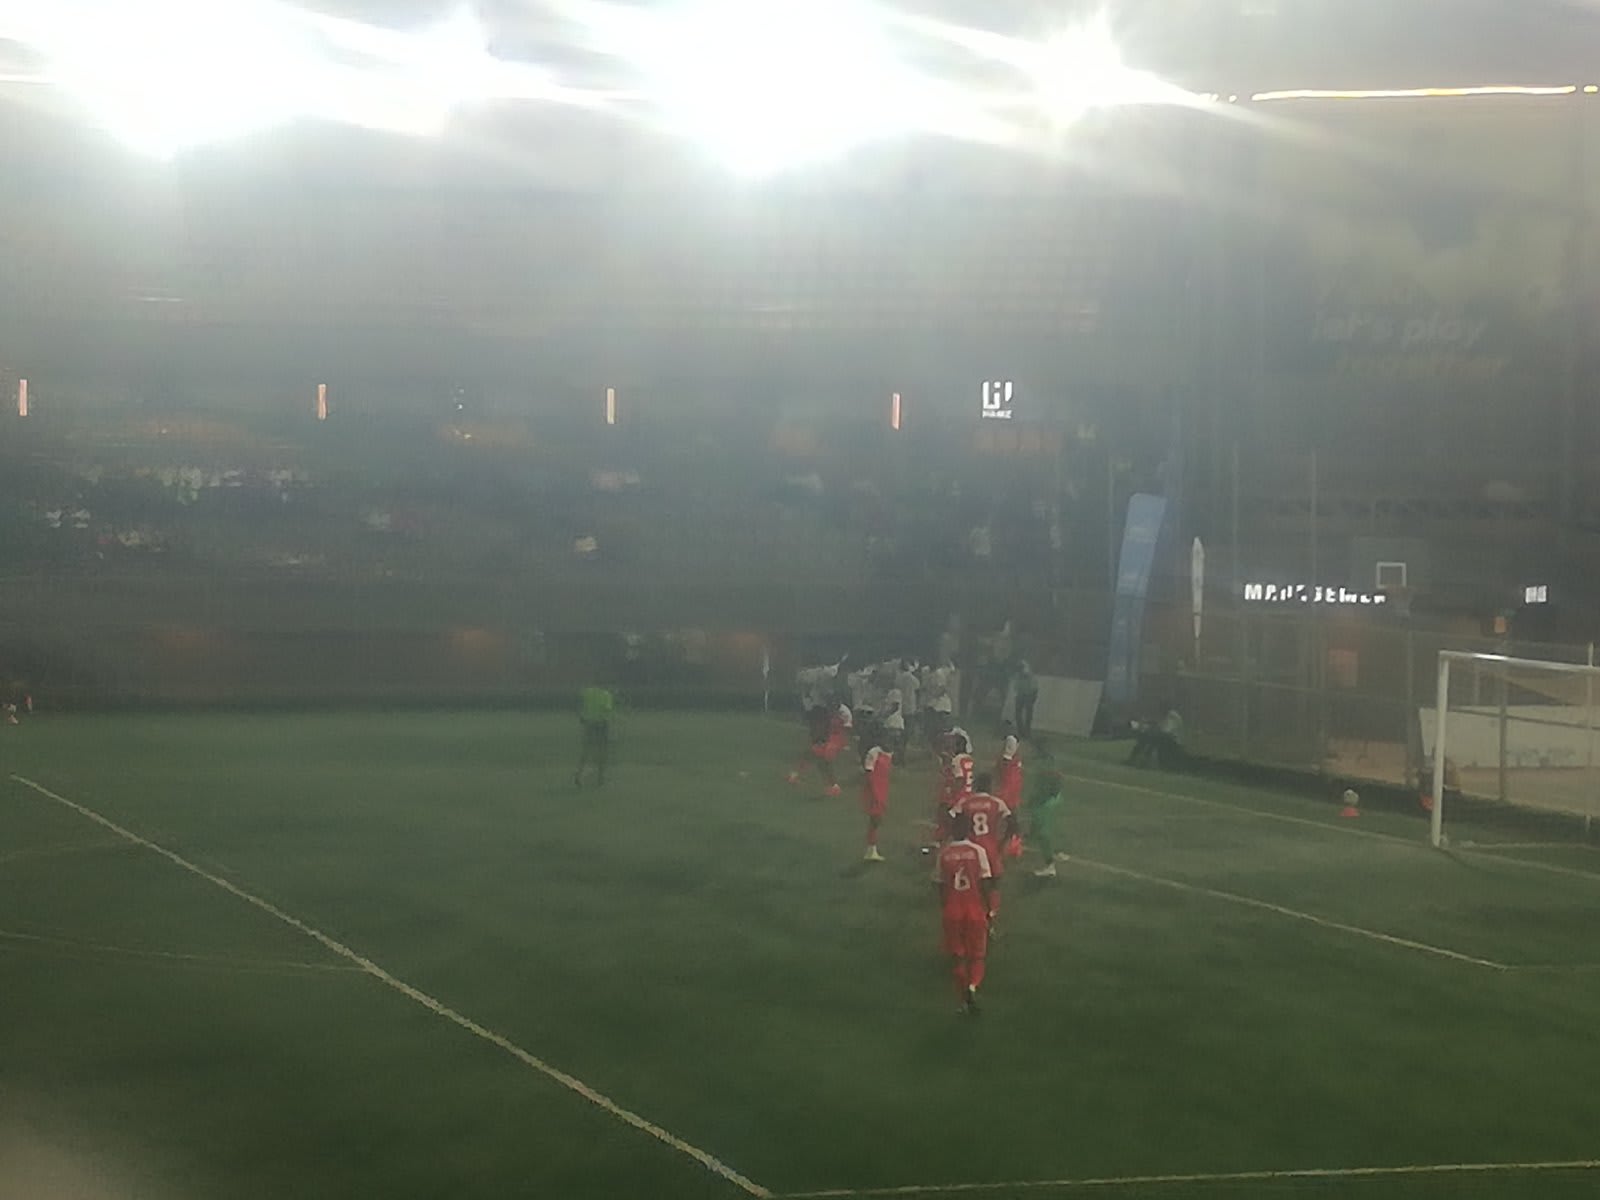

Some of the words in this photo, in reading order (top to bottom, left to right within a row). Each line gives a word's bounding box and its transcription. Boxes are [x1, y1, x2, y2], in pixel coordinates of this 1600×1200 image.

[1400, 311, 1489, 351] play
[972, 812, 989, 836] 8
[954, 866, 971, 891] 6
